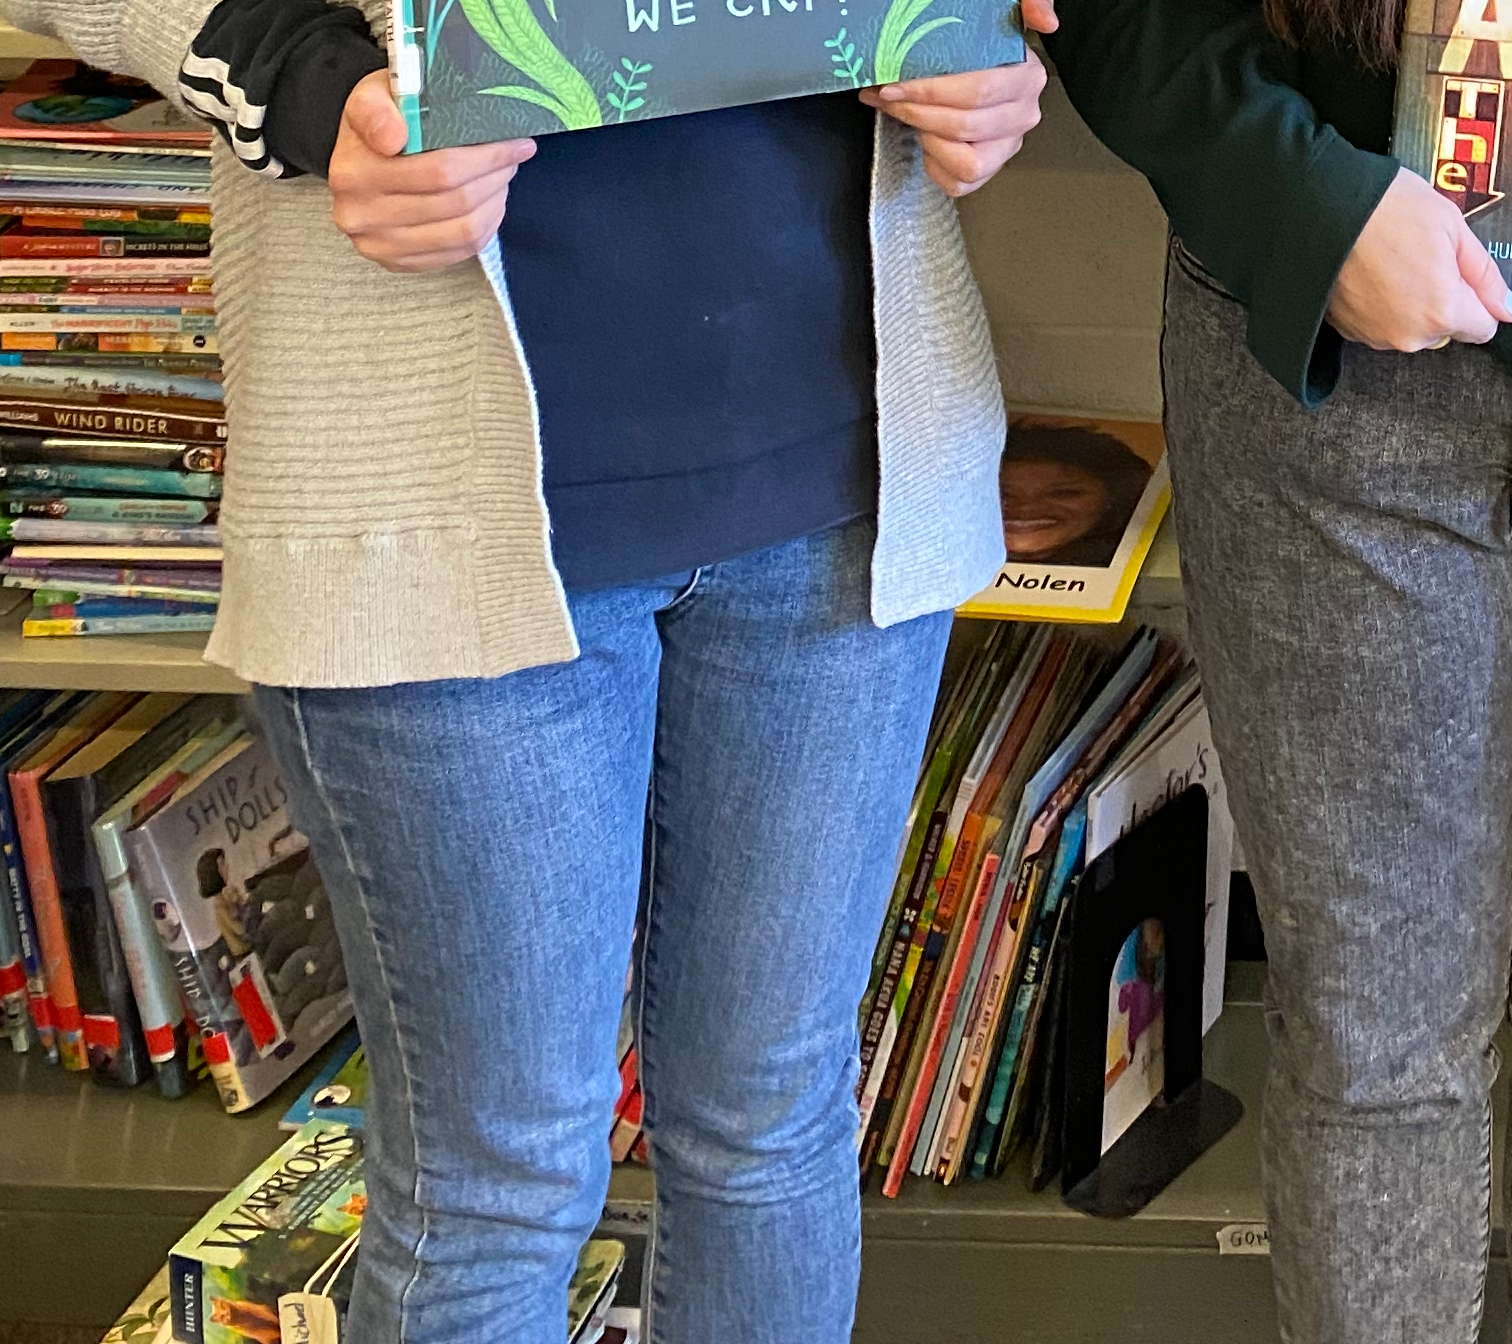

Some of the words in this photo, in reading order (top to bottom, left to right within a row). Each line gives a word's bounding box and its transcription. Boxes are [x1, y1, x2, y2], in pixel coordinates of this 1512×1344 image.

[54, 411, 109, 433] WIND
[114, 416, 168, 436] RIDER
[995, 570, 1087, 596] Nolen
[224, 777, 288, 844] DOLLS
[197, 1128, 363, 1249] WARRIORS
[184, 1273, 195, 1333] HUNTER
